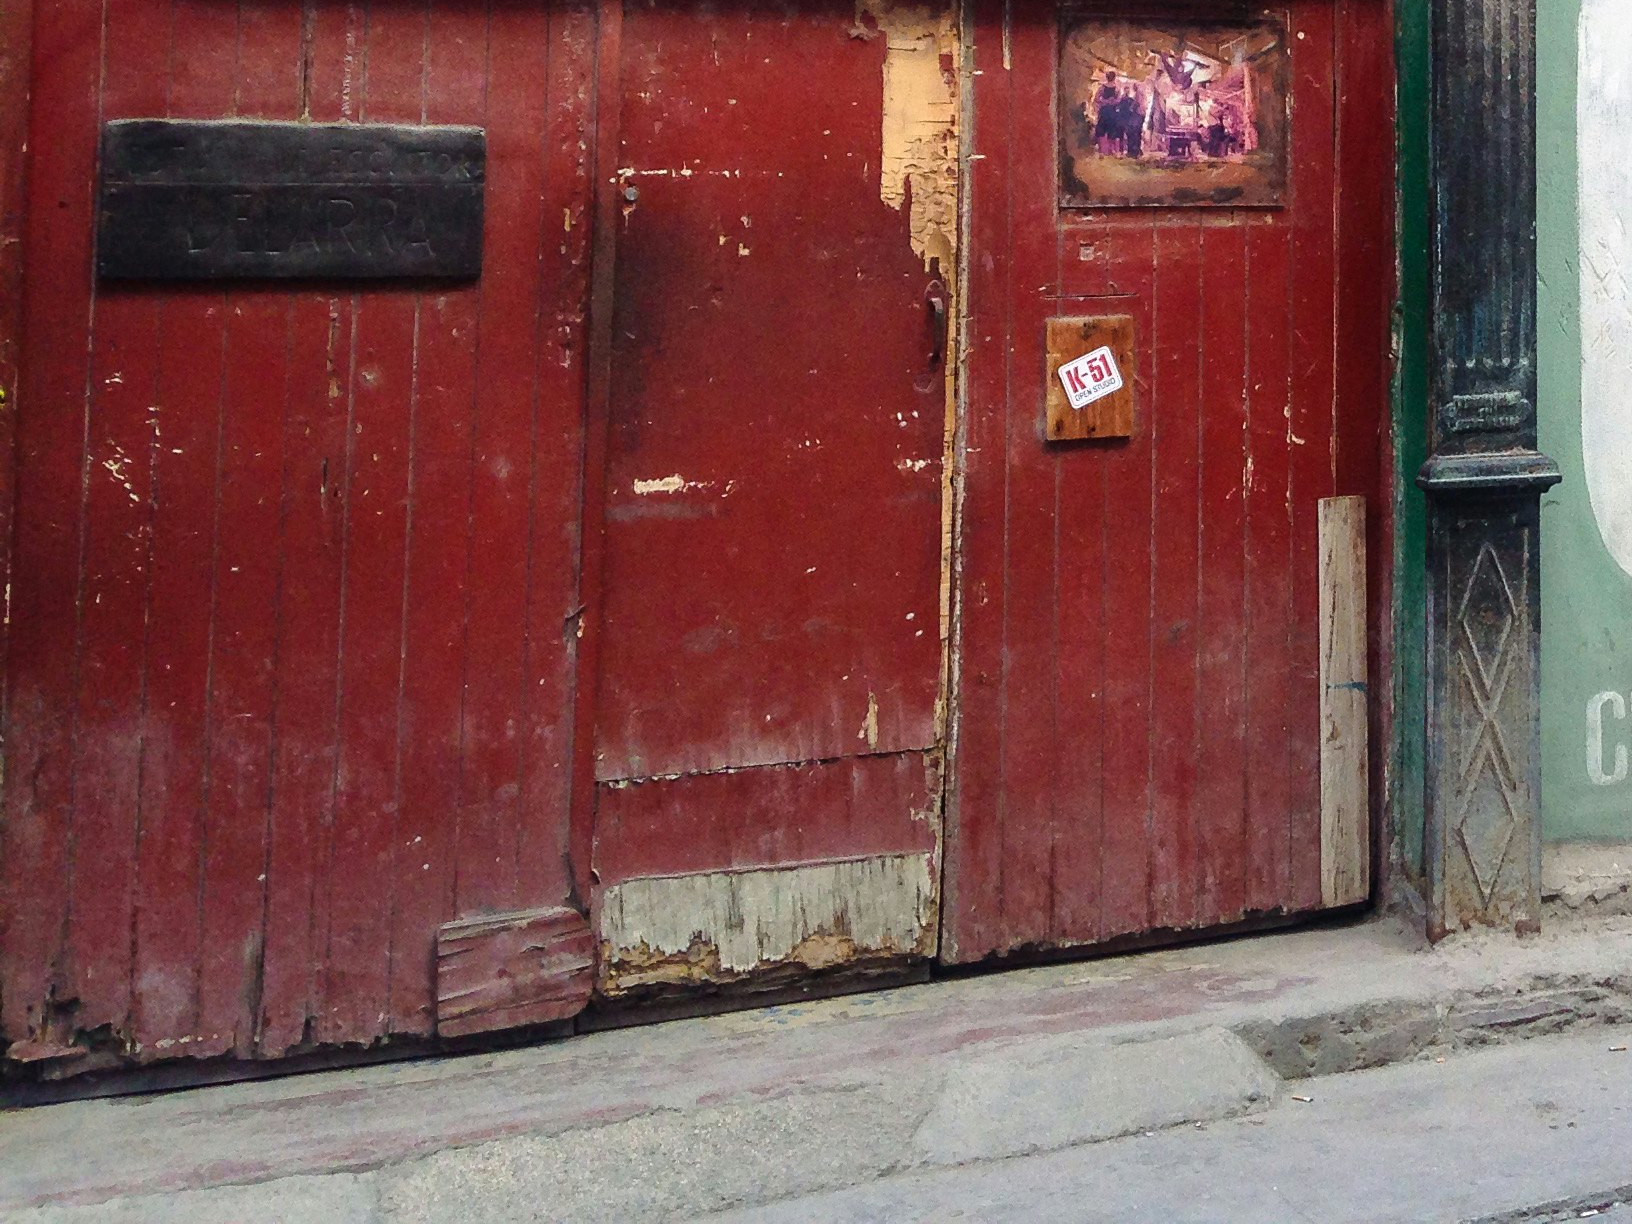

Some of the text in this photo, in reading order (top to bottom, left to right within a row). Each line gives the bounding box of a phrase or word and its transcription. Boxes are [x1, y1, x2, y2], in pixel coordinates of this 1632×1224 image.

[1065, 353, 1113, 393] K-51
[1074, 377, 1116, 402] OPEN STUDIO
